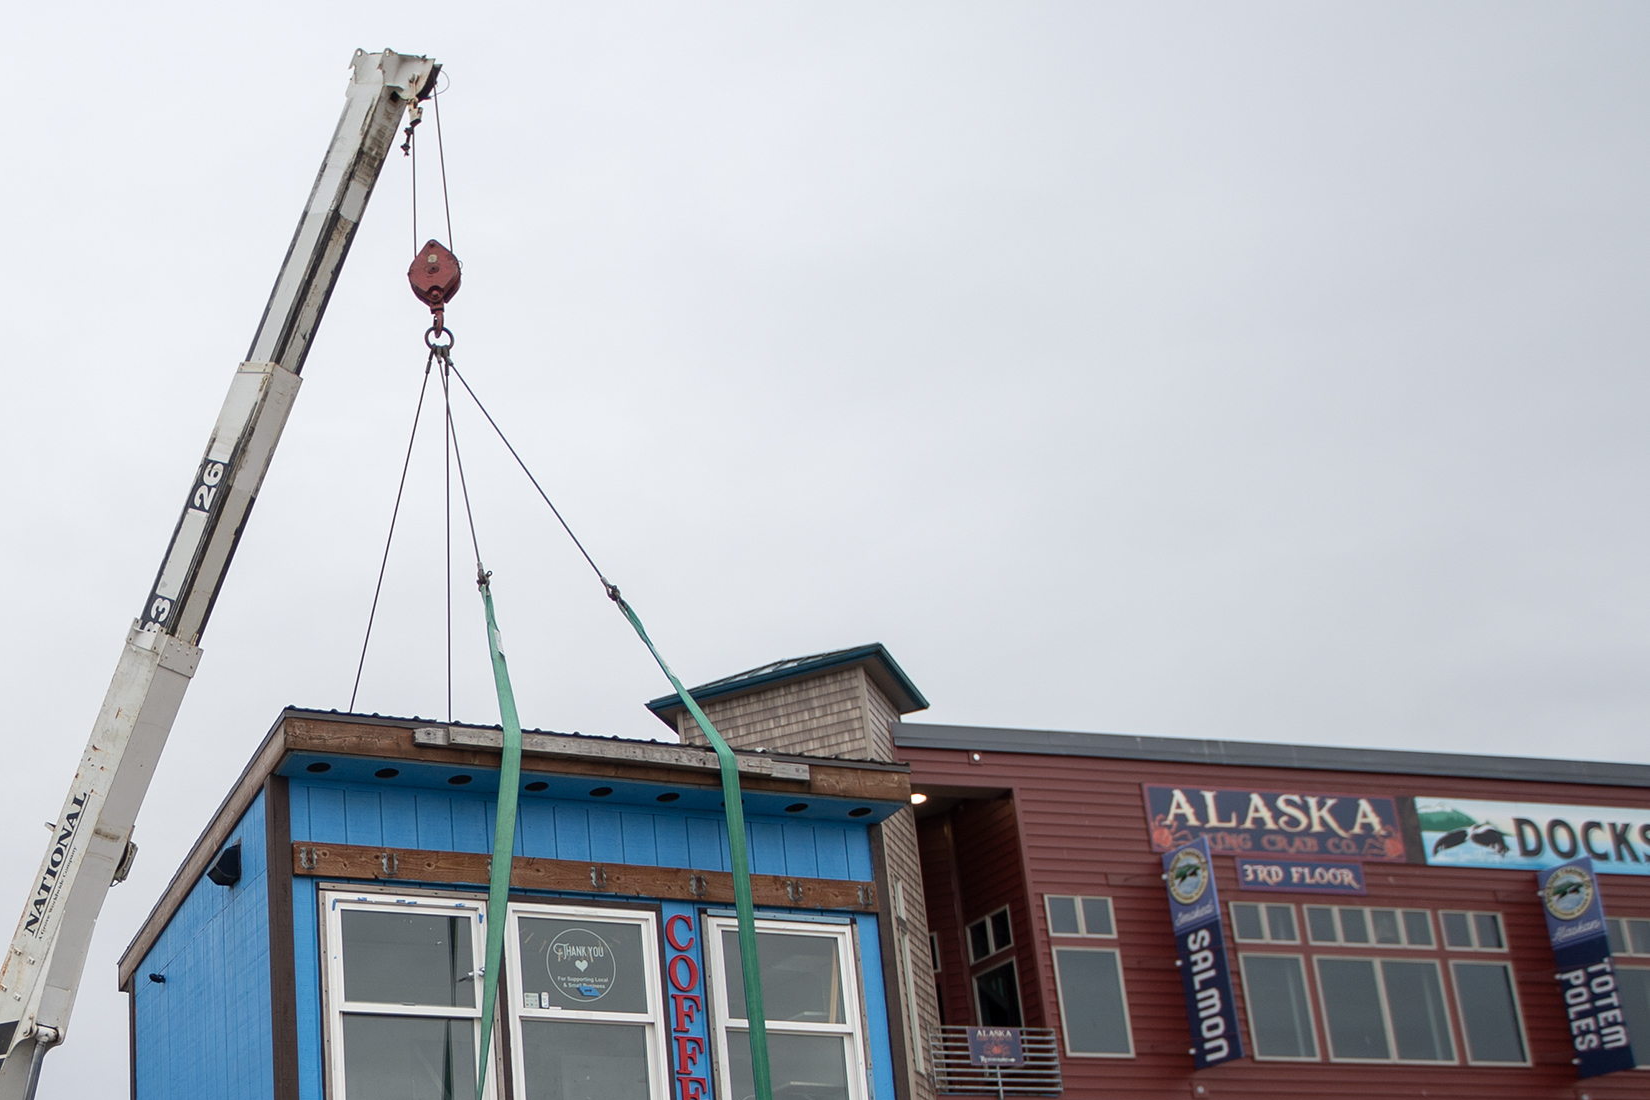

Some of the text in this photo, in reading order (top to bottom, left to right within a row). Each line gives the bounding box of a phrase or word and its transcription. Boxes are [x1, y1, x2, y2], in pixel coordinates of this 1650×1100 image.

[194, 462, 224, 510] 26
[1161, 788, 1387, 839] ALASKA
[24, 791, 88, 936] NATIONAL
[62, 846, 77, 878] Company
[1261, 834, 1319, 853] CRAB
[1242, 864, 1361, 890] 3RD FLOOR
[587, 946, 604, 957] YOU
[1187, 928, 1229, 1062] SALMON
[1560, 968, 1599, 1051] POLES
[1587, 957, 1629, 1050] TOTEM
[976, 1029, 1012, 1037] ALASKA
